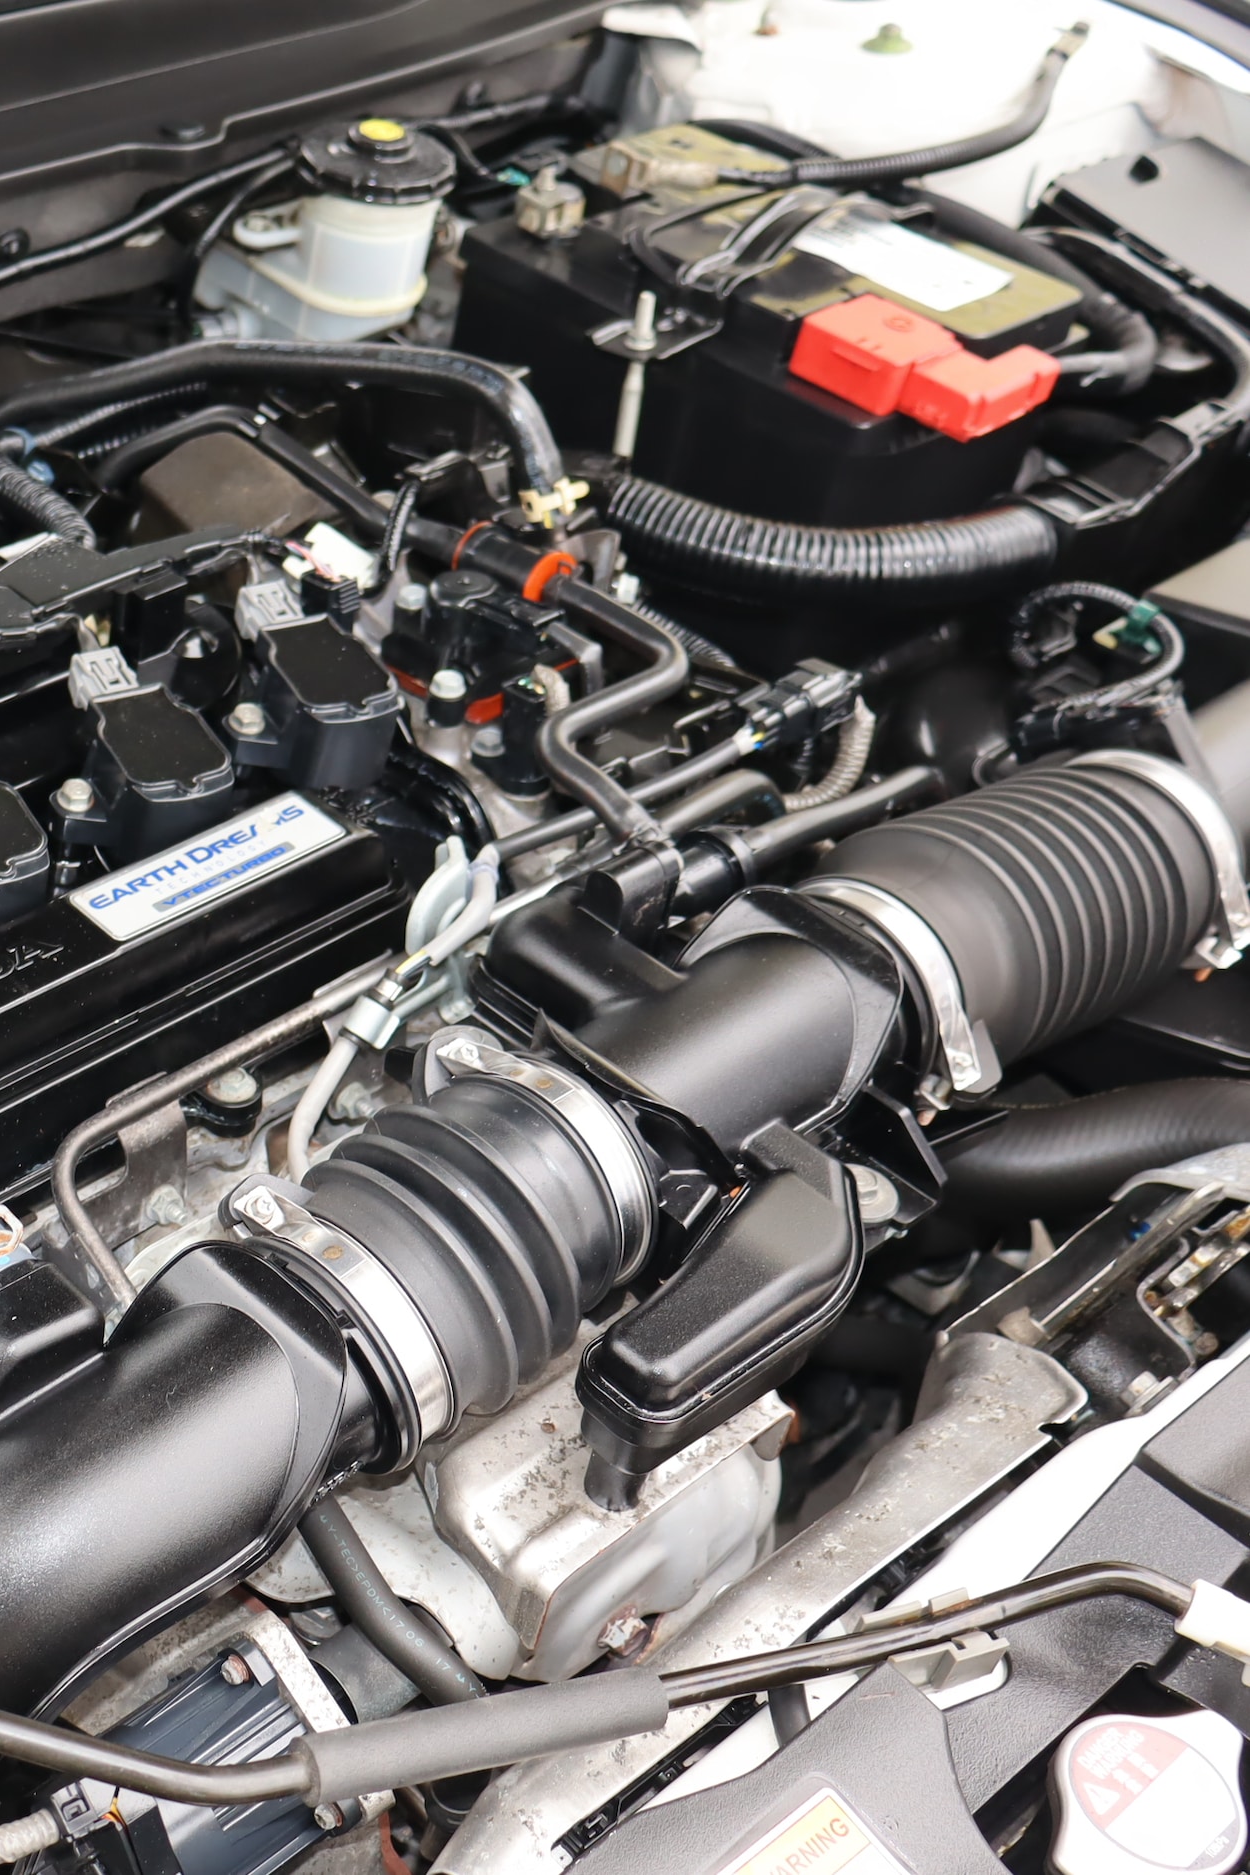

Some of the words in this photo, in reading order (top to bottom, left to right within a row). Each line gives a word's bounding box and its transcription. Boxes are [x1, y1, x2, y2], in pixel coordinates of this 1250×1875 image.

[89, 859, 189, 910] EARTH
[183, 804, 306, 865] DRES
[154, 838, 268, 896] TECHNOLOGY
[770, 1817, 850, 1875] ARNING
